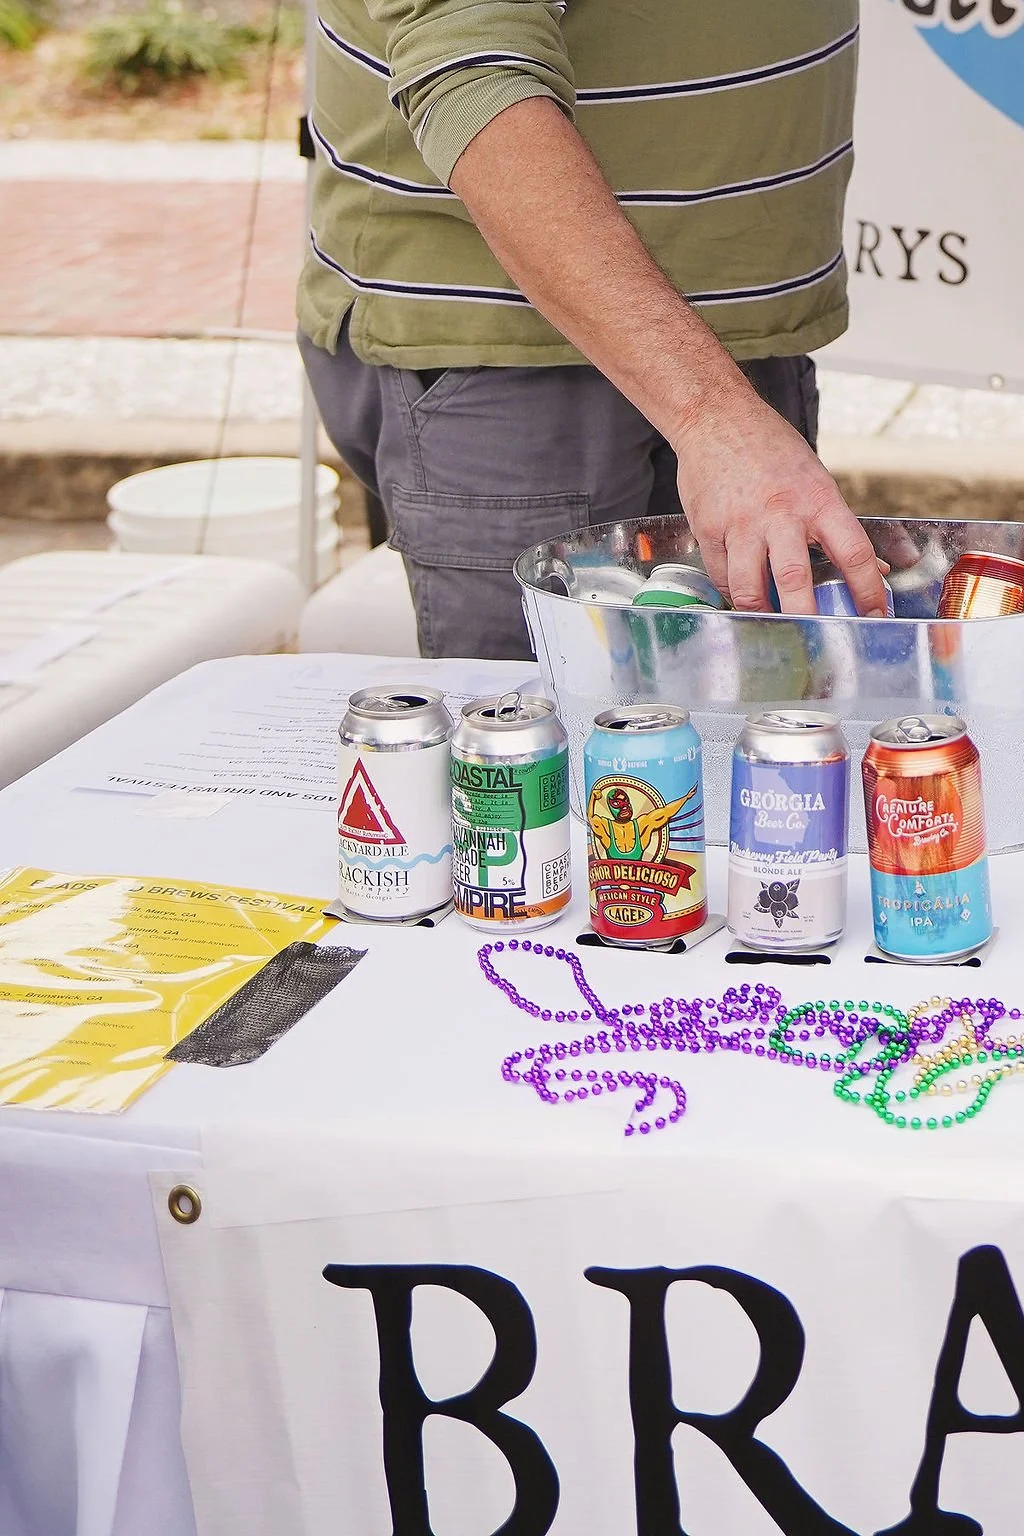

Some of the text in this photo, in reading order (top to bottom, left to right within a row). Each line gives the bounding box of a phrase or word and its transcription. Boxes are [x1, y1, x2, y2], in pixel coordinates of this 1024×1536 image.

[855, 220, 969, 285] RYS
[451, 759, 522, 788] OASTAL
[259, 788, 299, 799] AND
[301, 792, 338, 803] ADS
[876, 794, 935, 822] CREATURE
[888, 812, 959, 837] COMFORTS
[339, 838, 409, 856] ACKYARD ALE
[453, 824, 505, 850] AVANNAH
[774, 849, 804, 864] Field
[804, 848, 838, 864] Party
[339, 860, 409, 886] RACKISH
[613, 865, 679, 889] DELICIOSO
[753, 866, 801, 876] BLONDE ALE
[30, 879, 99, 891] ADS
[147, 886, 221, 902] BREWS
[224, 895, 317, 914] FESTIVAL
[599, 891, 657, 906] MEXICAN STYLE
[609, 907, 646, 922] LAGER
[910, 916, 933, 927] IPA
